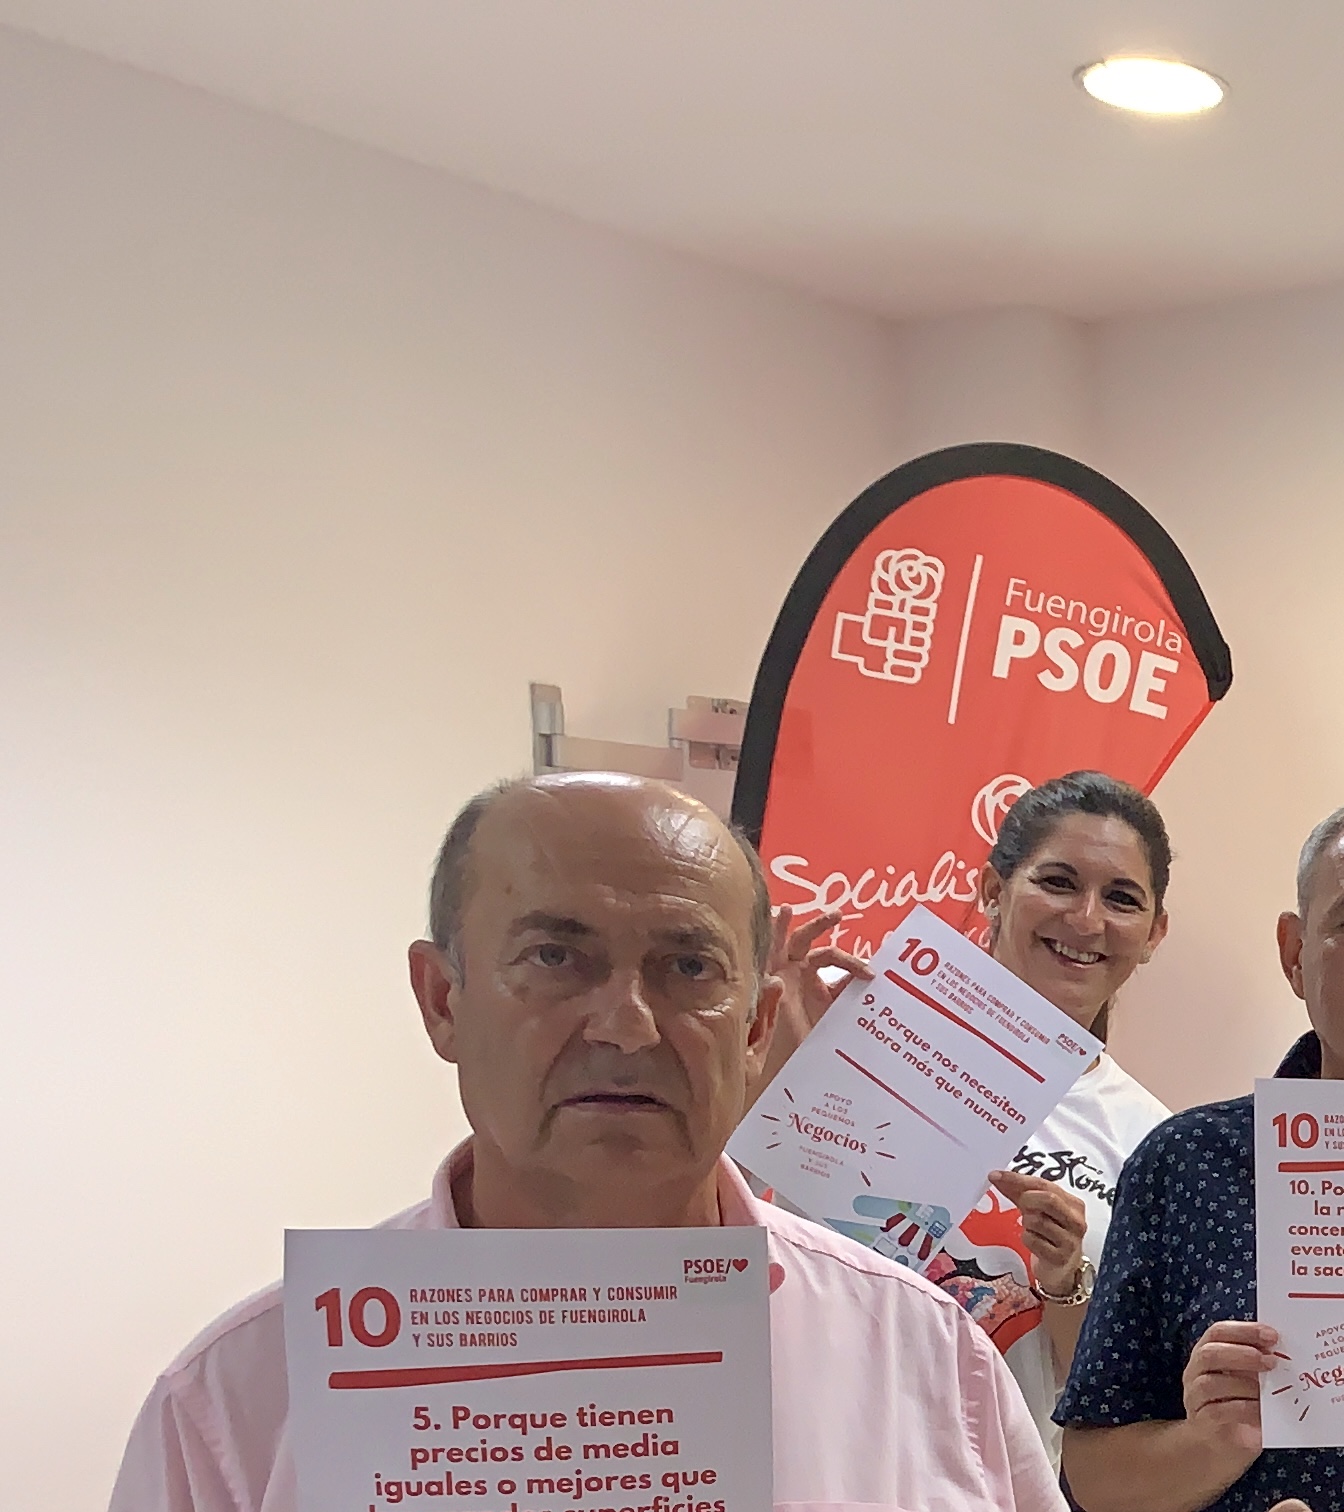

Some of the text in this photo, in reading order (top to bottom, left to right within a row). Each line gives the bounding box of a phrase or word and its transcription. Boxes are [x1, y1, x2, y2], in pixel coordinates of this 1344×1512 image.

[1005, 577, 1183, 654] Fuengirola
[992, 614, 1180, 720] PSOE
[770, 851, 984, 916] Socialis
[897, 937, 941, 977] 10
[856, 1016, 1009, 1134] ahora más que nunca
[861, 993, 1027, 1125] 9. Porque nos necesitan
[788, 1113, 868, 1155] Negocios
[1272, 1112, 1320, 1149] 10
[1289, 1179, 1316, 1196] 10.
[1314, 1199, 1331, 1216] la
[1291, 1259, 1308, 1276] la
[409, 1285, 678, 1303] RAZONES PARA COMPRAR Y CONSUMIR
[314, 1286, 402, 1348] 10
[410, 1307, 647, 1326] EN LOS NEGOCIOS DE FUENGIROLA
[411, 1332, 518, 1348] Y SUS BARRIOS
[412, 1403, 674, 1437] 5. Porque tienen
[410, 1432, 679, 1471] precios de media
[374, 1468, 717, 1504] iguales o mejores que
